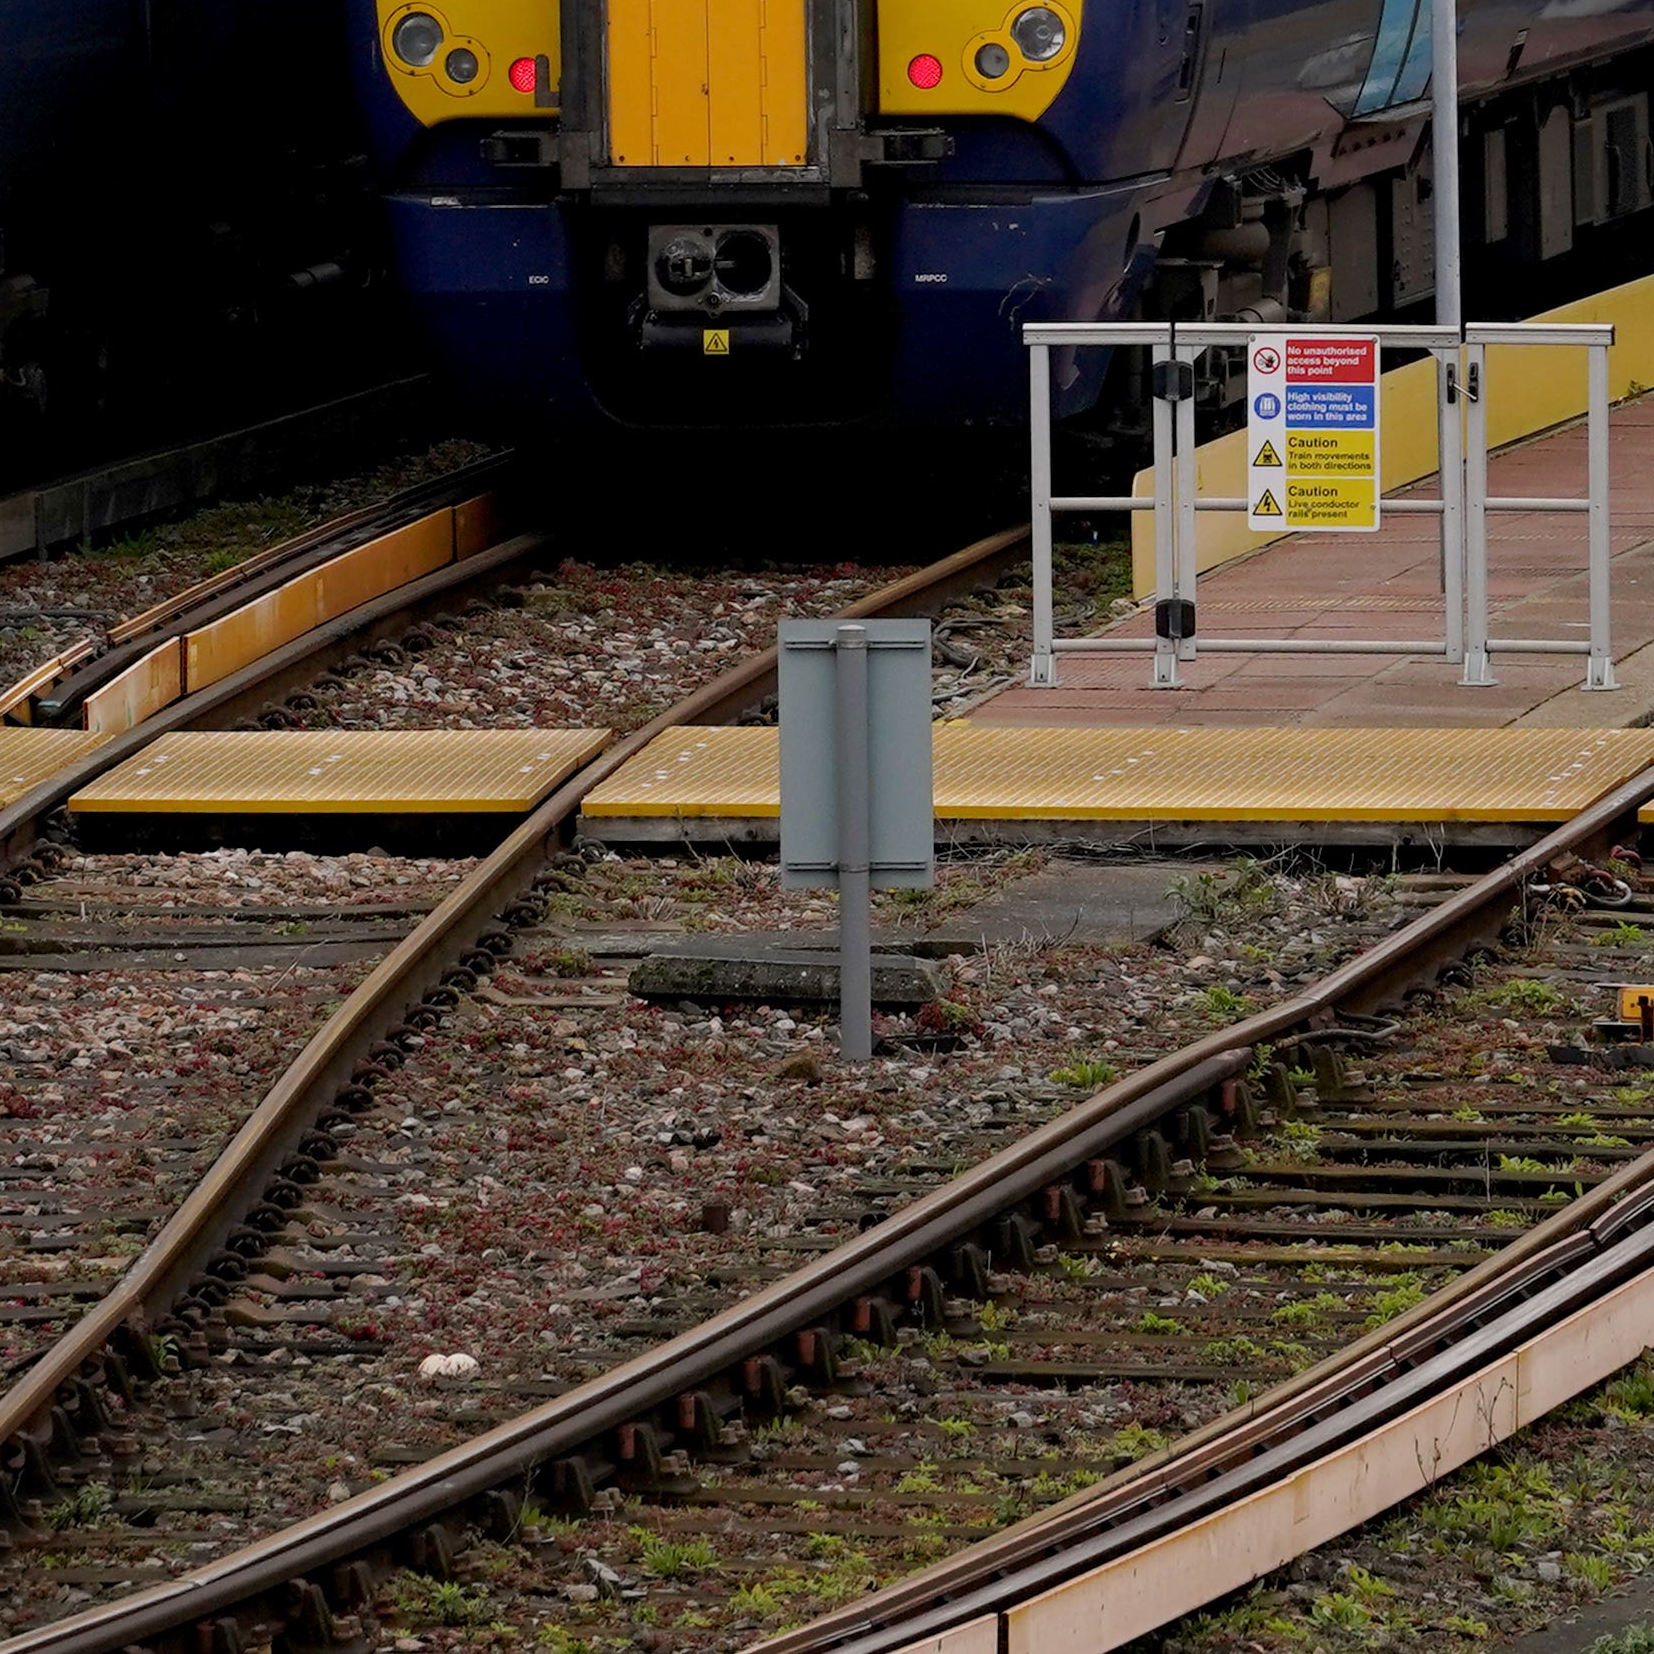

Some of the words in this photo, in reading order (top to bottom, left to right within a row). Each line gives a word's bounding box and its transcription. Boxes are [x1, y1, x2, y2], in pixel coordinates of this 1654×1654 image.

[1287, 346, 1301, 355] No
[1303, 346, 1367, 355] unauthorised
[1287, 357, 1321, 365] access
[1323, 356, 1360, 367] beyond
[1287, 366, 1306, 375] this
[1307, 366, 1333, 376] point
[1287, 392, 1311, 402] High
[1312, 392, 1352, 403] visibility
[1287, 402, 1327, 413] clothing
[1328, 402, 1353, 411] must
[1355, 402, 1368, 411] be
[1287, 413, 1312, 421] worn
[1314, 412, 1324, 421] in
[1325, 412, 1344, 421] this
[1345, 413, 1367, 421] area
[1288, 436, 1338, 448] Caution
[1288, 451, 1313, 460] Train
[1314, 451, 1370, 460] movements
[1288, 462, 1298, 470] in
[1299, 461, 1322, 470] both
[1323, 461, 1372, 470] directions
[1288, 485, 1338, 497] Caution
[1288, 500, 1309, 508] Live
[1310, 499, 1360, 508] conductor
[1288, 510, 1309, 519] rails
[1311, 510, 1347, 520] present
